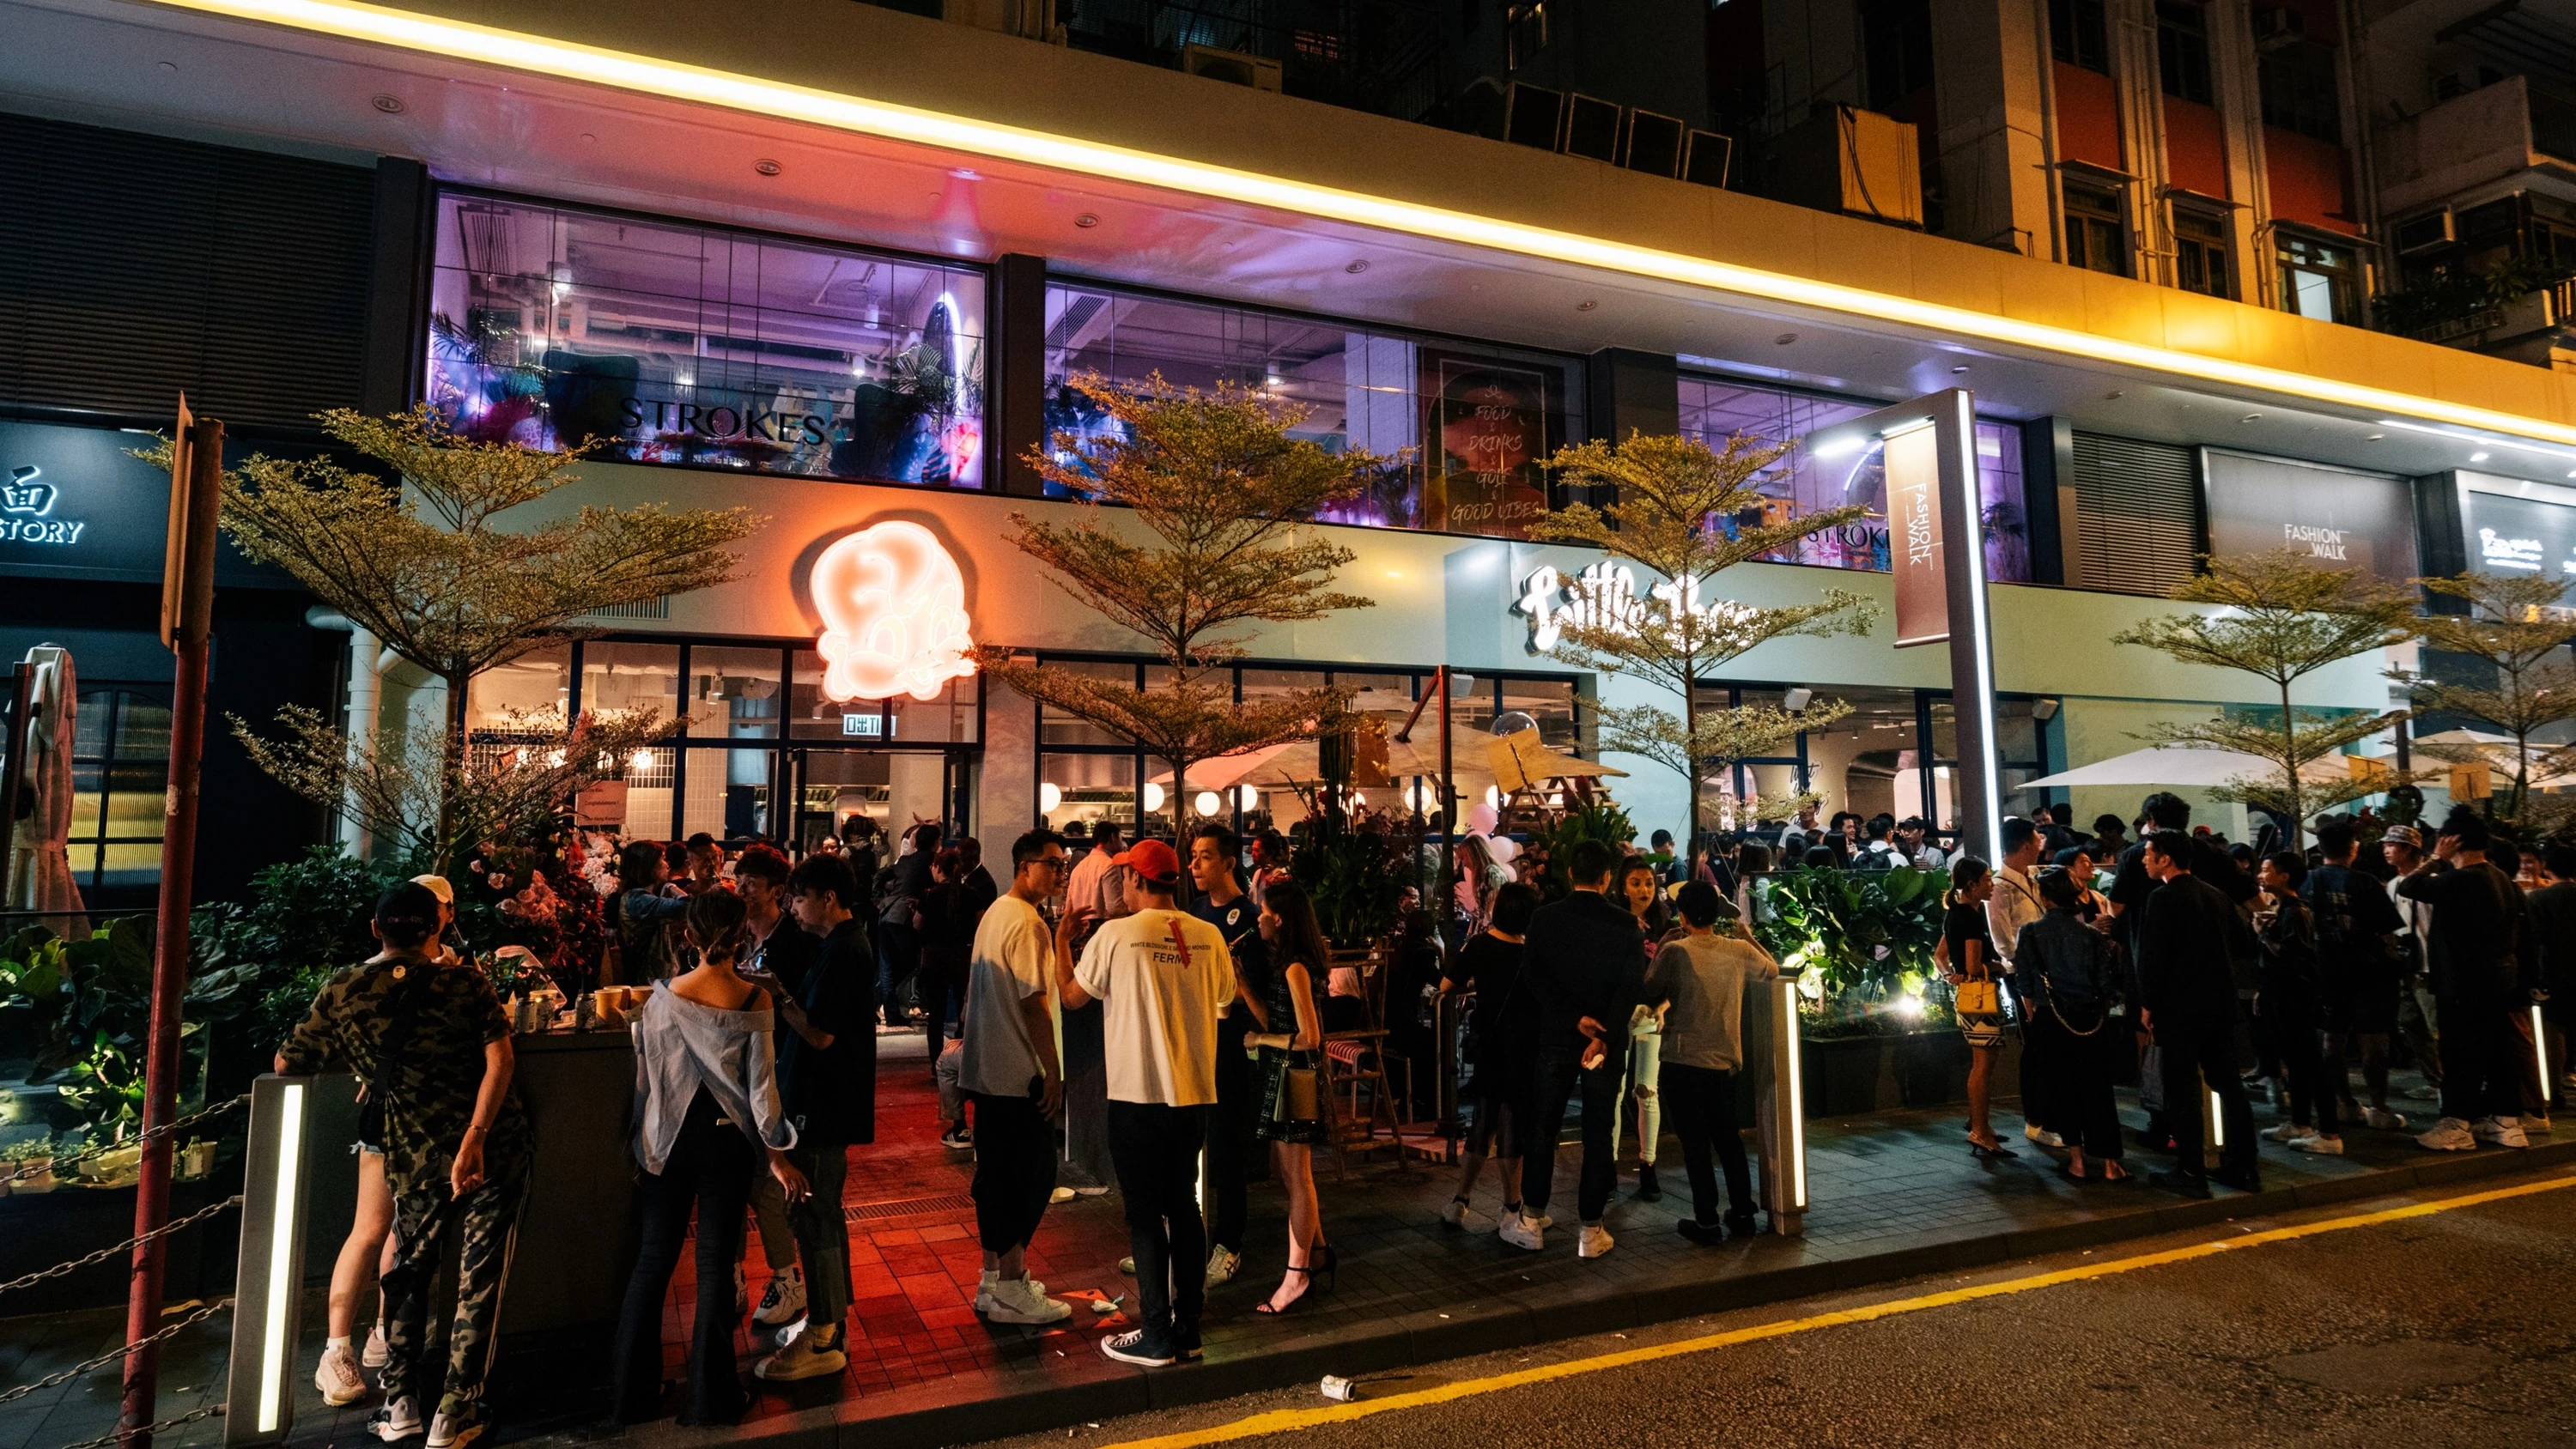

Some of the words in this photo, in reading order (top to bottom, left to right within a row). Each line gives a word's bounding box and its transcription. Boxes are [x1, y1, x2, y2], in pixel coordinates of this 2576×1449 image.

[619, 397, 826, 446] STROKES
[1475, 404, 1512, 421] FOOD
[1468, 433, 1522, 452] DRINKS
[1476, 468, 1513, 488] GOLF
[1451, 503, 1494, 526] GOOD
[1498, 501, 1540, 521] VIBES
[1915, 483, 1931, 558] FASHION
[1907, 518, 1923, 566] WALK
[2284, 523, 2342, 544] FASHION
[2311, 542, 2347, 561] WALK
